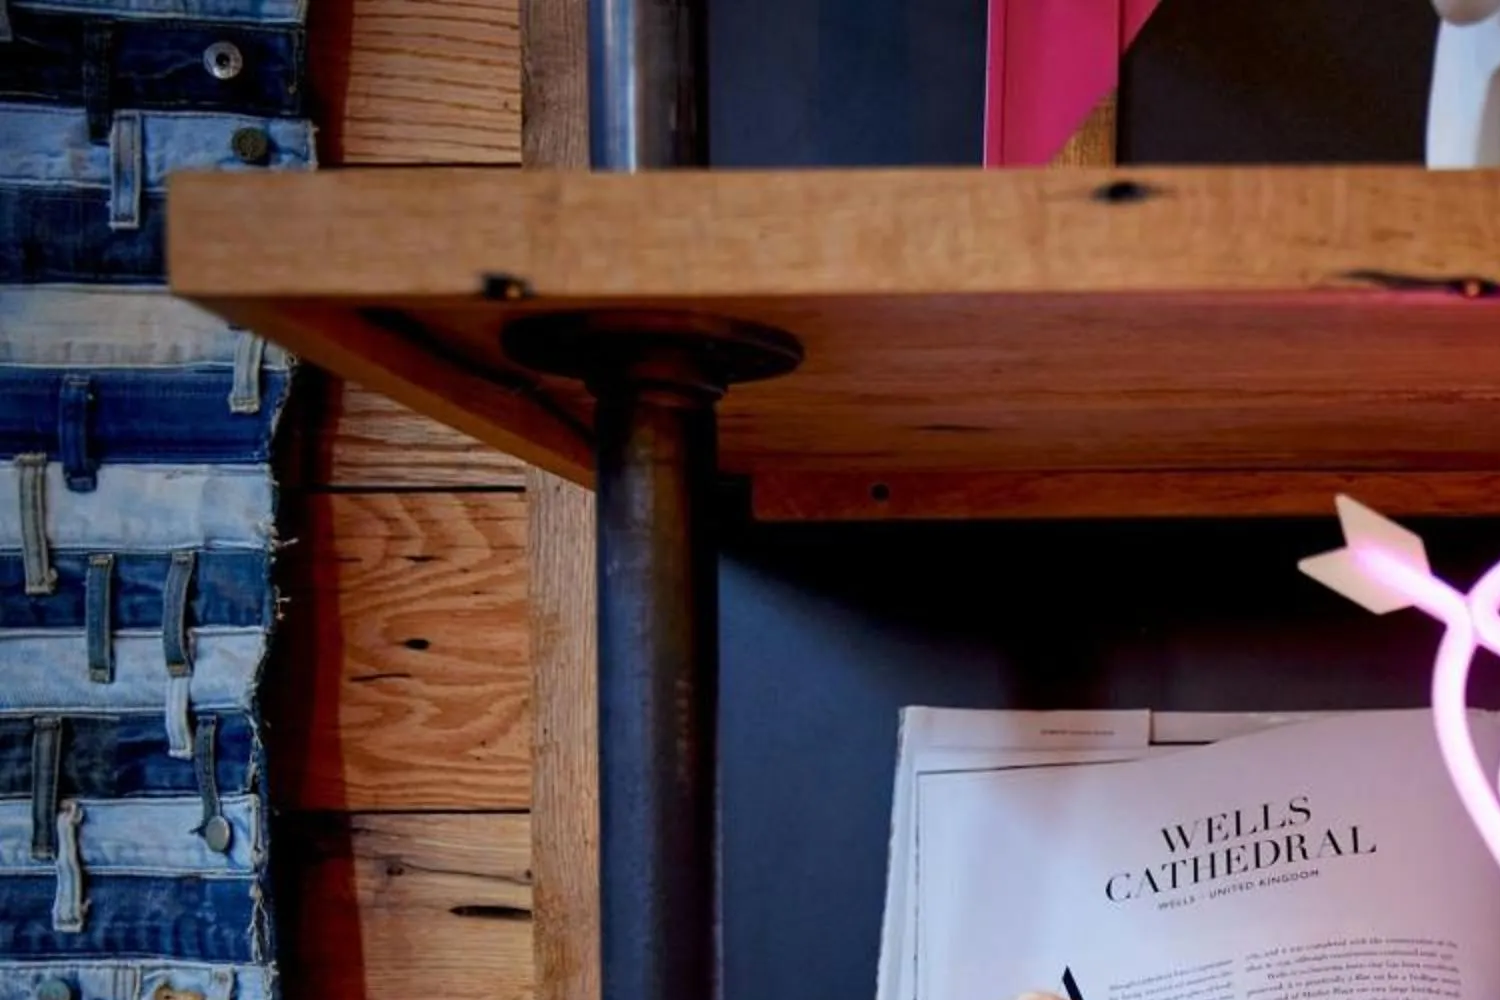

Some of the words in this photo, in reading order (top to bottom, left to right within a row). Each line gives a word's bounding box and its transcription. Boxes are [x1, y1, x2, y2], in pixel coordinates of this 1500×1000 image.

[1158, 795, 1312, 854] WELLS
[1104, 823, 1378, 903] CATHEDRAL
[1209, 881, 1255, 900] UNITED
[1259, 868, 1320, 887] KINGDOM
